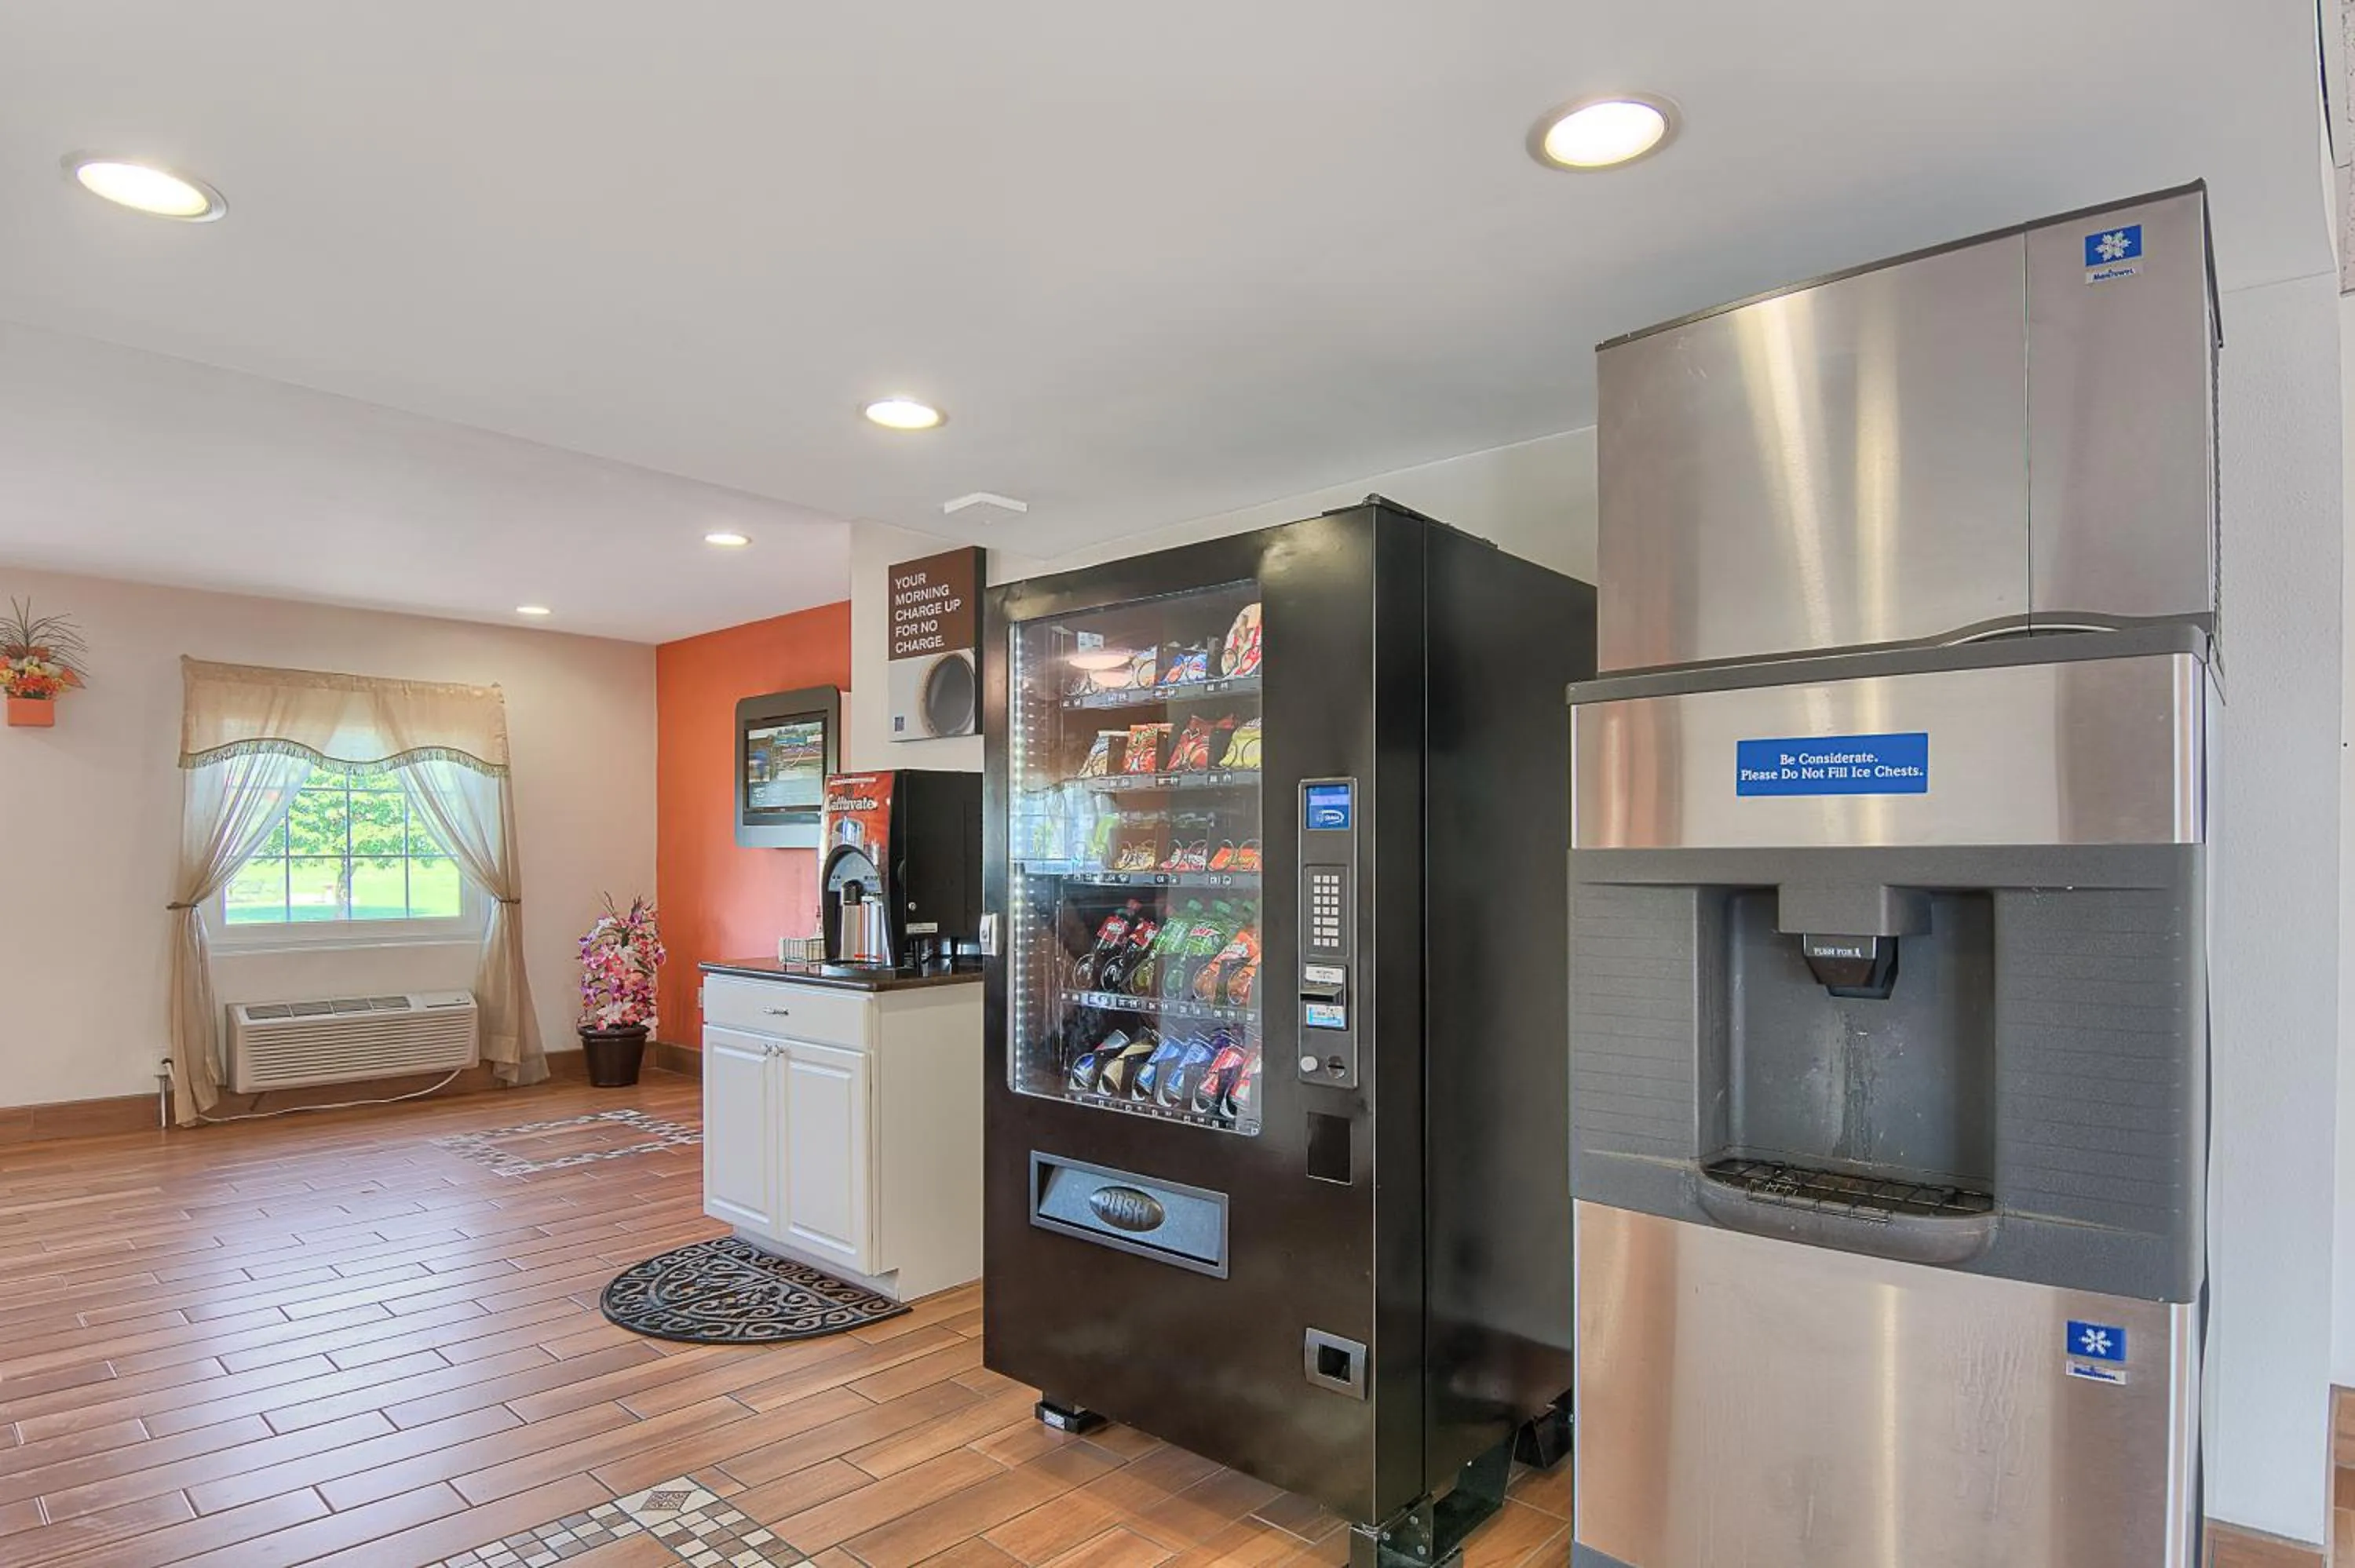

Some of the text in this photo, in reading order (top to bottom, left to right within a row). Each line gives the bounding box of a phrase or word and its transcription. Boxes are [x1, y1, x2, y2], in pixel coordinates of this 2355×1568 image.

[895, 573, 926, 589] YOUR
[895, 584, 949, 605] MORNING
[895, 599, 961, 622] CHARGE UP
[896, 620, 938, 637] FOR NO
[1780, 753, 1878, 765] Be Considerate.
[1740, 765, 1923, 781] Please Do Not Fill Ice Chests.
[1101, 1192, 1149, 1223] PUSH
